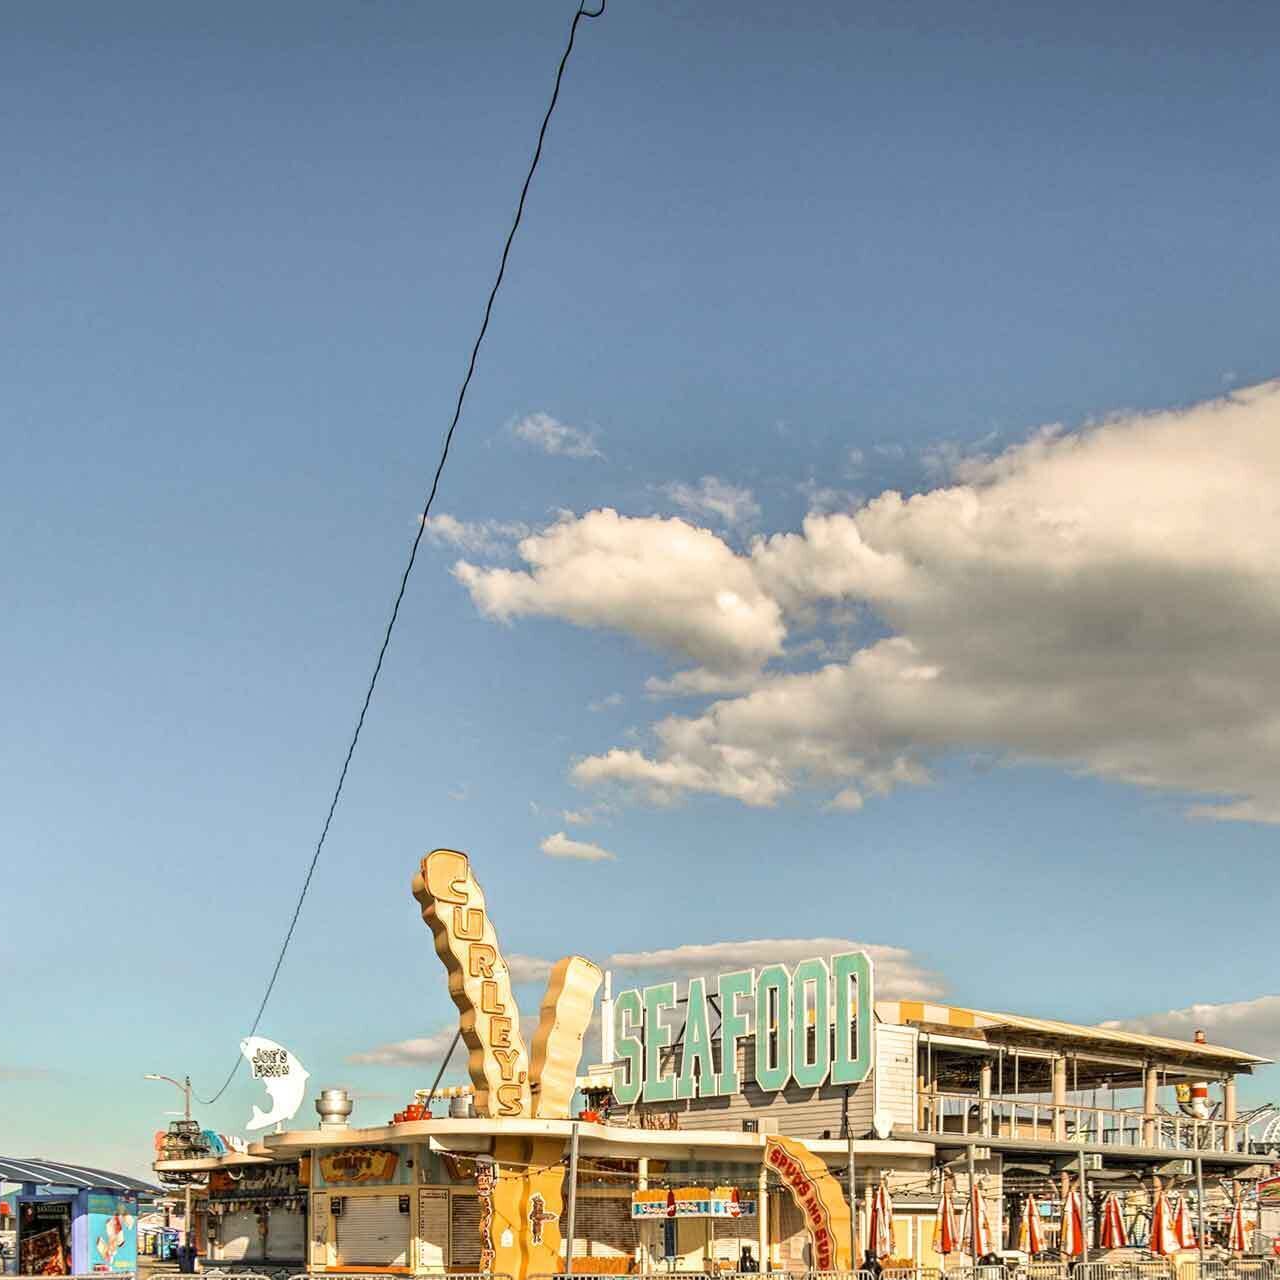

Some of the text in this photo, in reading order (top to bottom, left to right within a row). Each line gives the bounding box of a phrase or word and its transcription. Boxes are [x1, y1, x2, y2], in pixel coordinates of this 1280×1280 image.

[423, 849, 526, 1117] CURLEY'S
[613, 950, 874, 1105] SEAFOOD
[251, 1048, 288, 1063] JOE'S
[254, 1064, 281, 1077] FISH
[770, 1148, 830, 1270] SPUDS AND SUD
